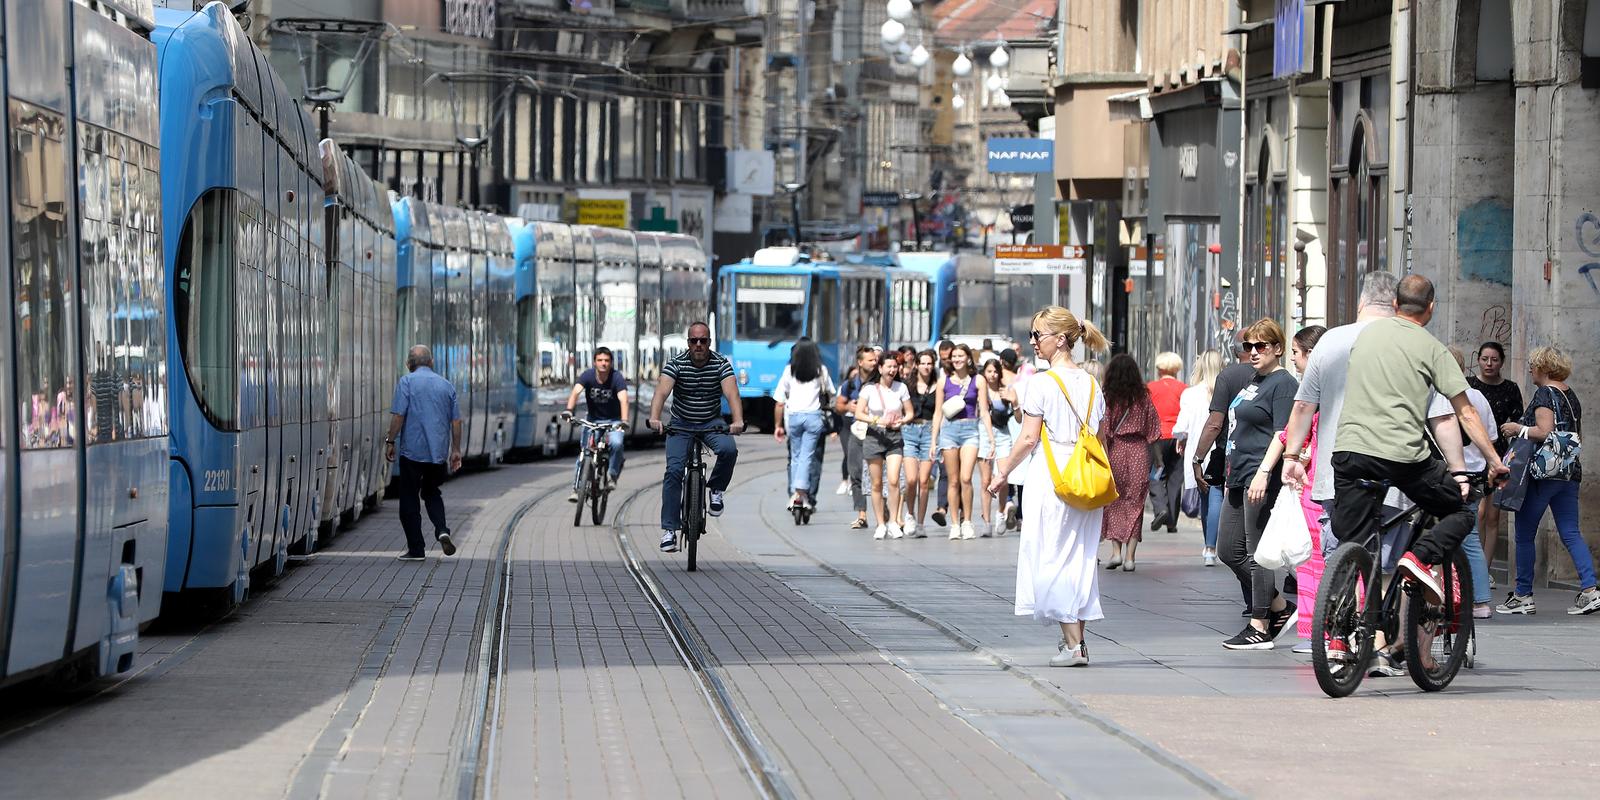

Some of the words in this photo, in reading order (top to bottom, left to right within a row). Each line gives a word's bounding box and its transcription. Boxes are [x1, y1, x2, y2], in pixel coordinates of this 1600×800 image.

[989, 151, 1018, 159] NAF
[1020, 151, 1049, 159] NAF
[204, 469, 230, 491] 22130
